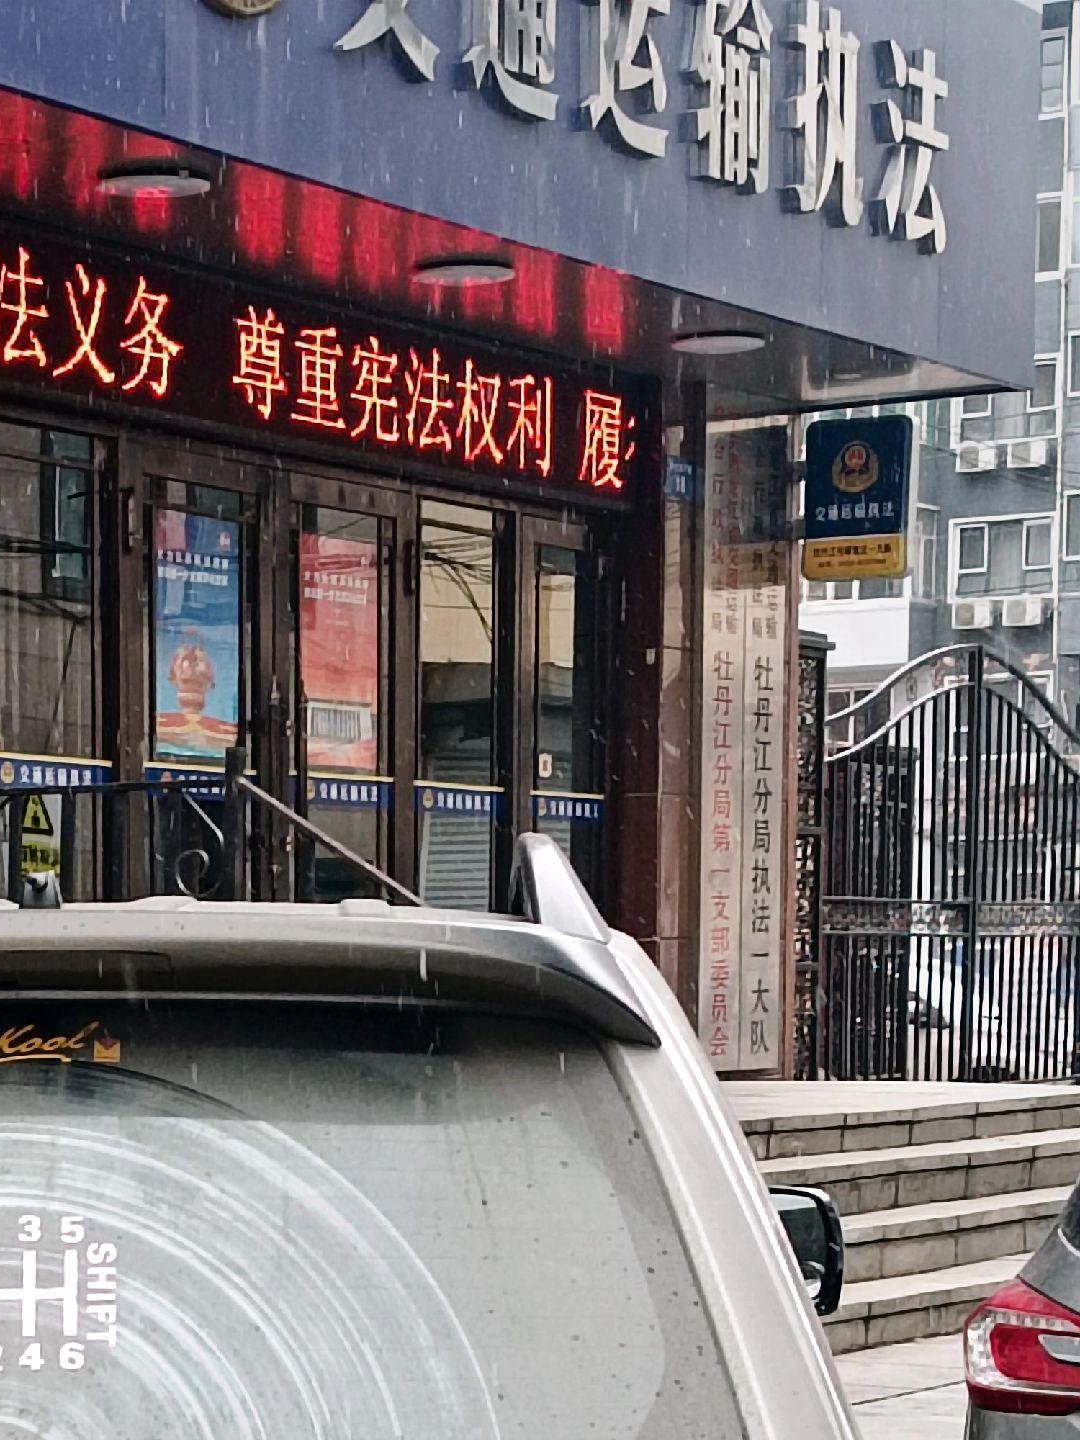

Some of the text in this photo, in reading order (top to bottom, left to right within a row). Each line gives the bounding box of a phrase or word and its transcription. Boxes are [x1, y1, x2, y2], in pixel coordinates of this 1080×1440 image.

[232, 305, 554, 479] 尊重宪法权利
[578, 389, 636, 489] 履
[17, 1213, 42, 1243] 3
[59, 1215, 86, 1245] 5
[85, 1242, 118, 1347] SHIFT
[18, 1342, 45, 1371] 4
[58, 1342, 86, 1371] 6
